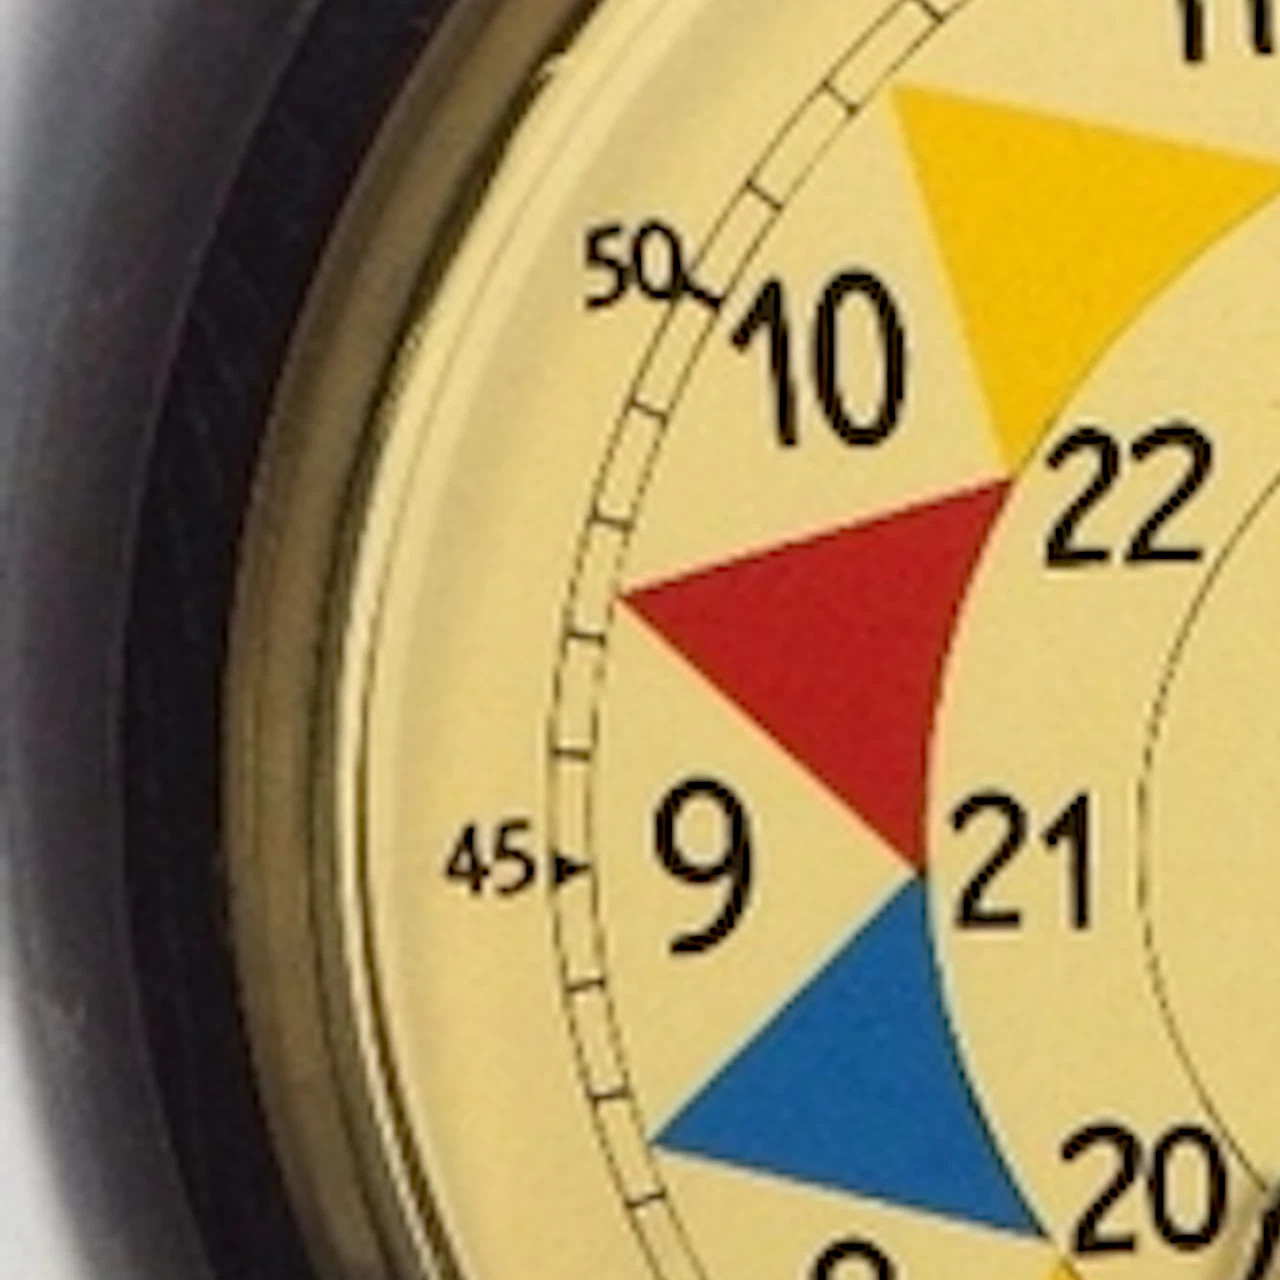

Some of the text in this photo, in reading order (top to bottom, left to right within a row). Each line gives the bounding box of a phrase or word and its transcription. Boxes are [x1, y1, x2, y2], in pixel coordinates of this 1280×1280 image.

[584, 218, 683, 311] 50
[729, 272, 907, 449] 10
[1042, 421, 1212, 569] 22
[442, 821, 536, 897] 45
[653, 776, 754, 956] 9
[950, 790, 1090, 931] 21
[1061, 1121, 1230, 1258] 20
